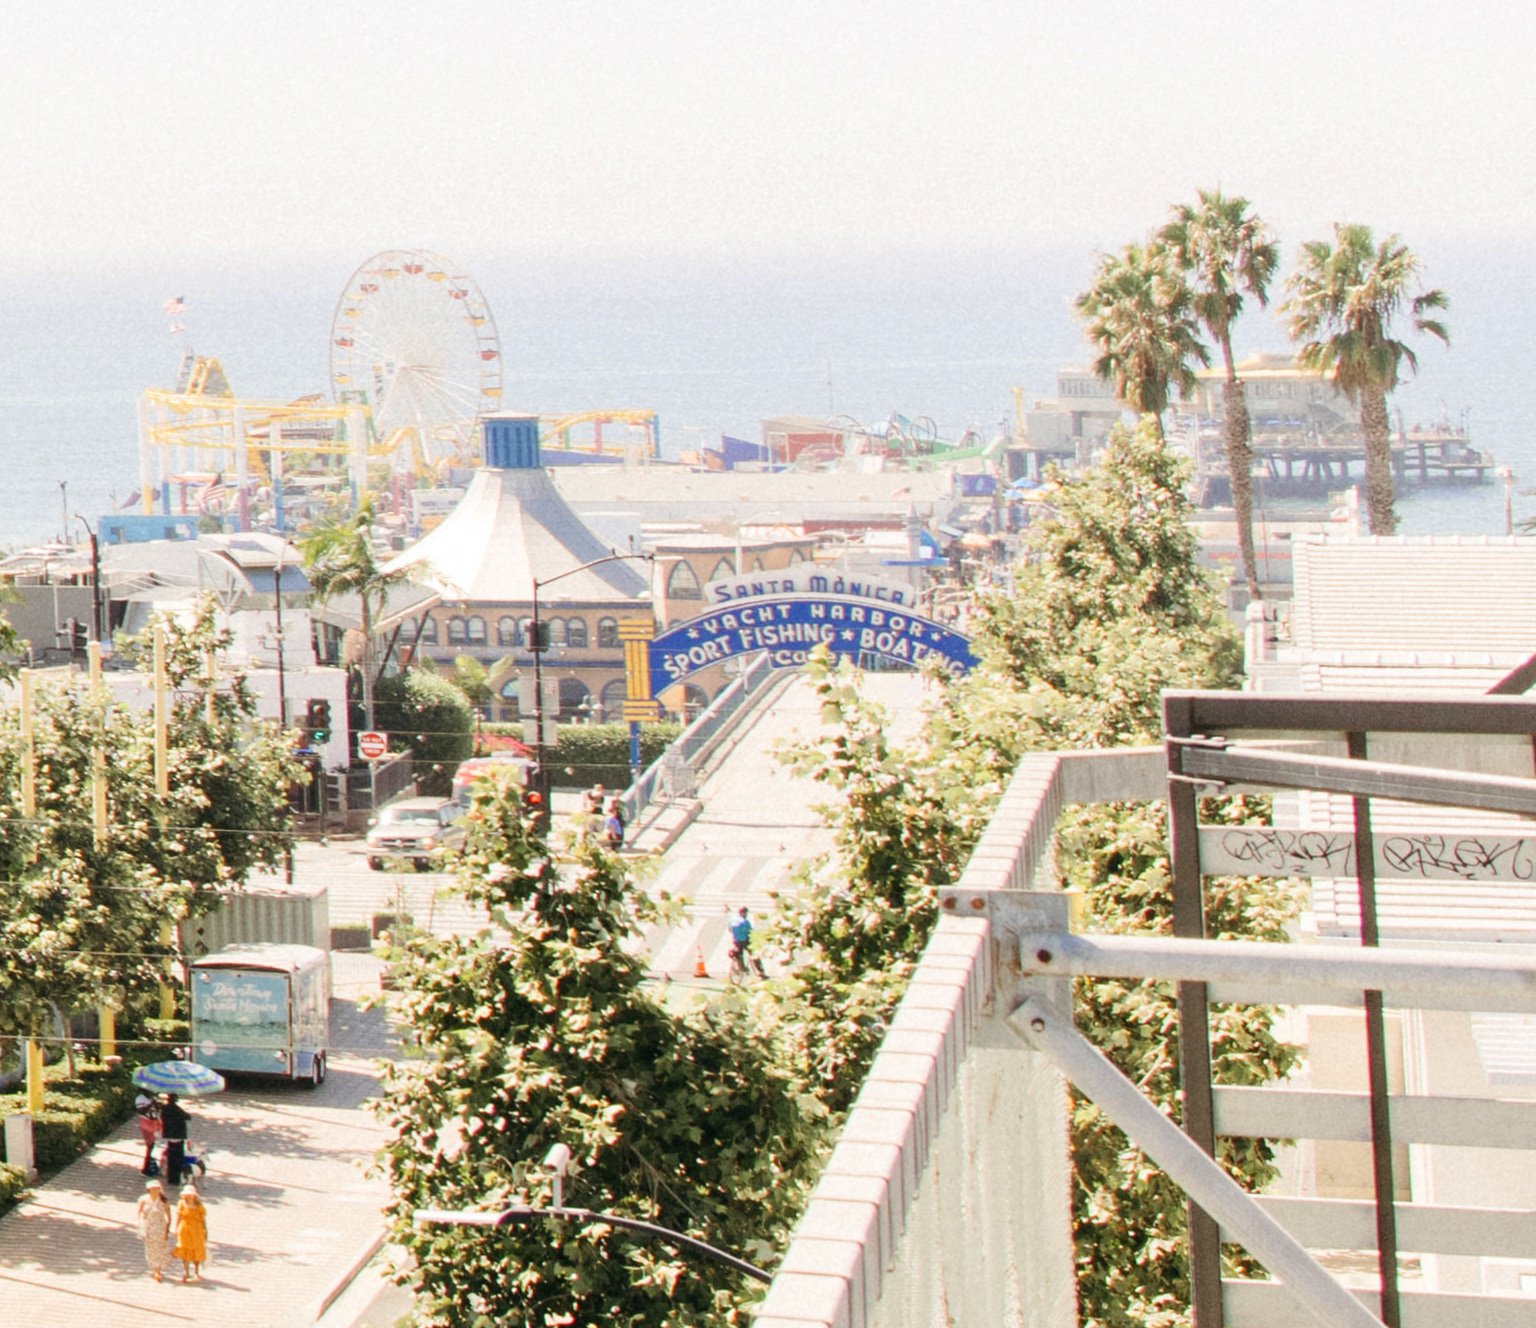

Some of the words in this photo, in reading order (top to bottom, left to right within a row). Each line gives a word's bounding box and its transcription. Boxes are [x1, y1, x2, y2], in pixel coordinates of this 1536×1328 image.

[714, 579, 794, 603] SANTA
[809, 575, 904, 605] MONICA
[703, 604, 791, 635] YACHT
[810, 603, 924, 638] HARBOR
[663, 635, 732, 679] SPORT
[739, 623, 835, 649] FISHING
